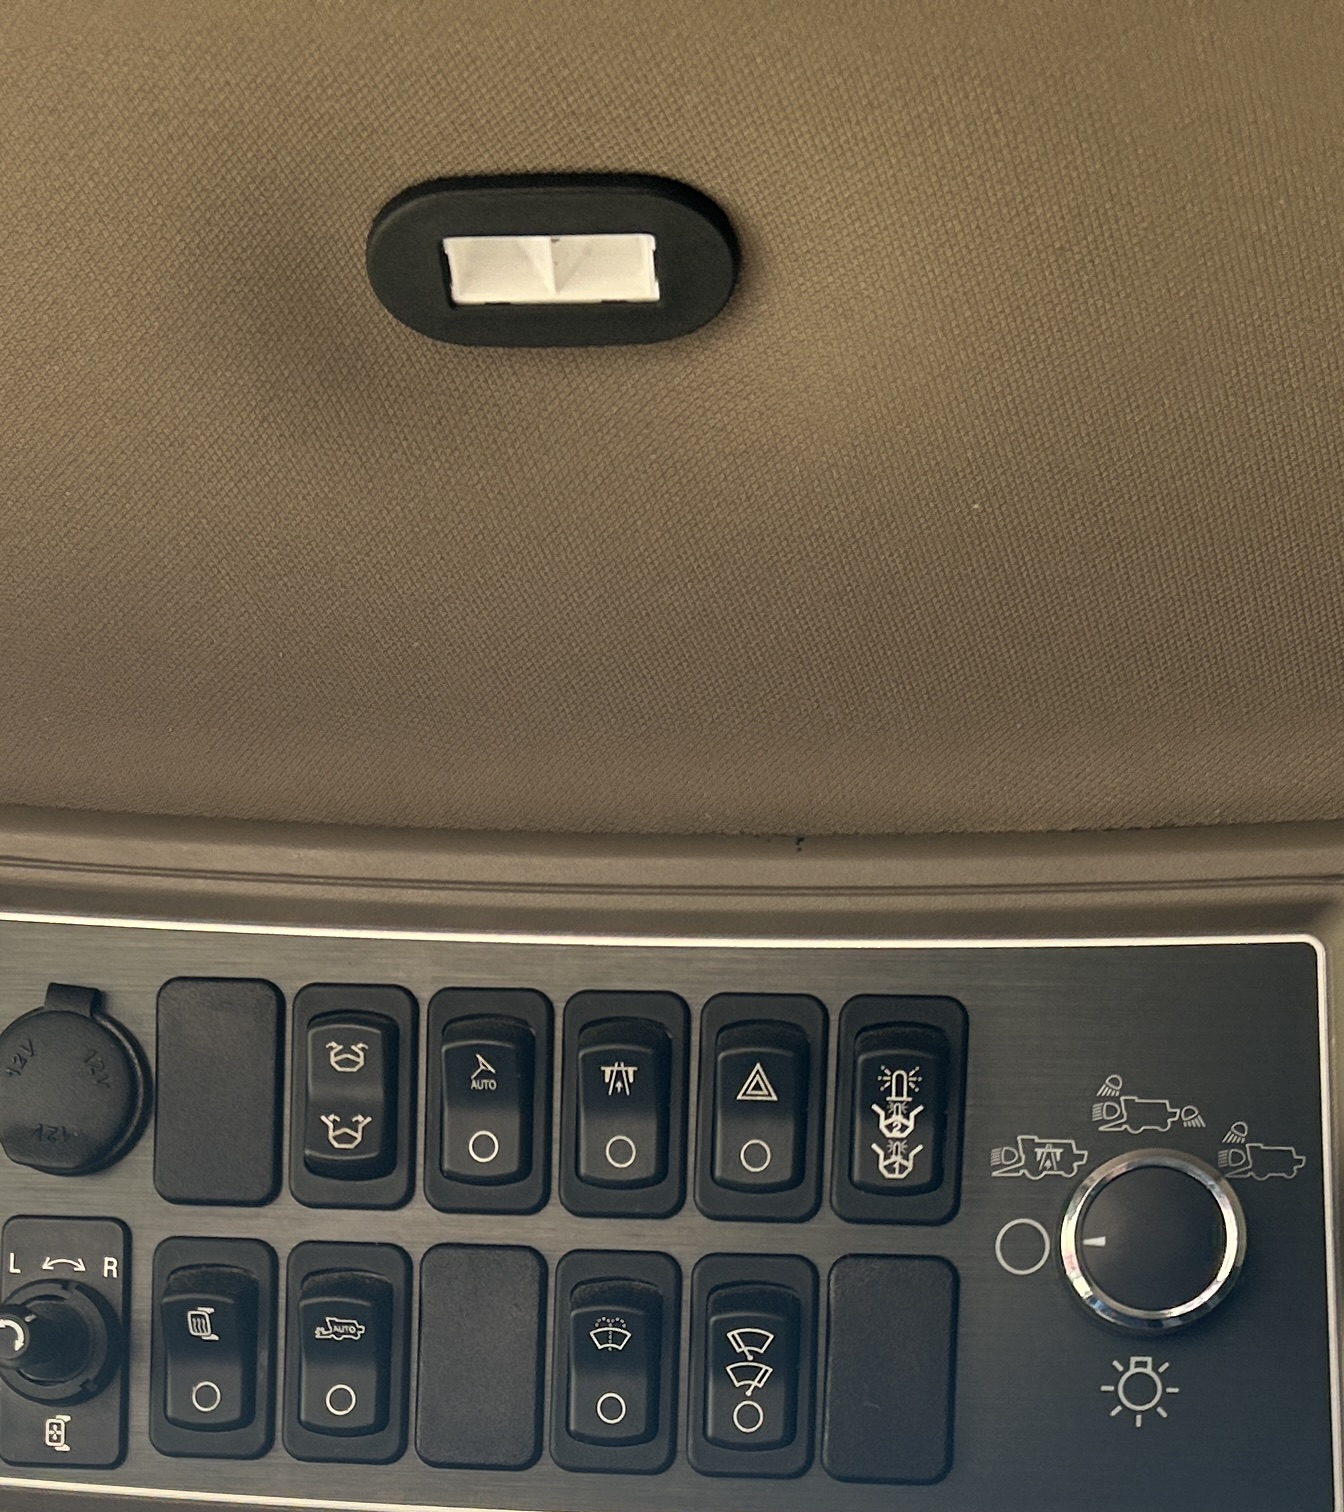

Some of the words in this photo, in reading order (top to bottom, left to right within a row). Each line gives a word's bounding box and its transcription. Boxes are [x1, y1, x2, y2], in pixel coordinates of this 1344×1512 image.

[470, 1079, 497, 1091] AUTO
[9, 1253, 21, 1275] L
[103, 1258, 119, 1279] R
